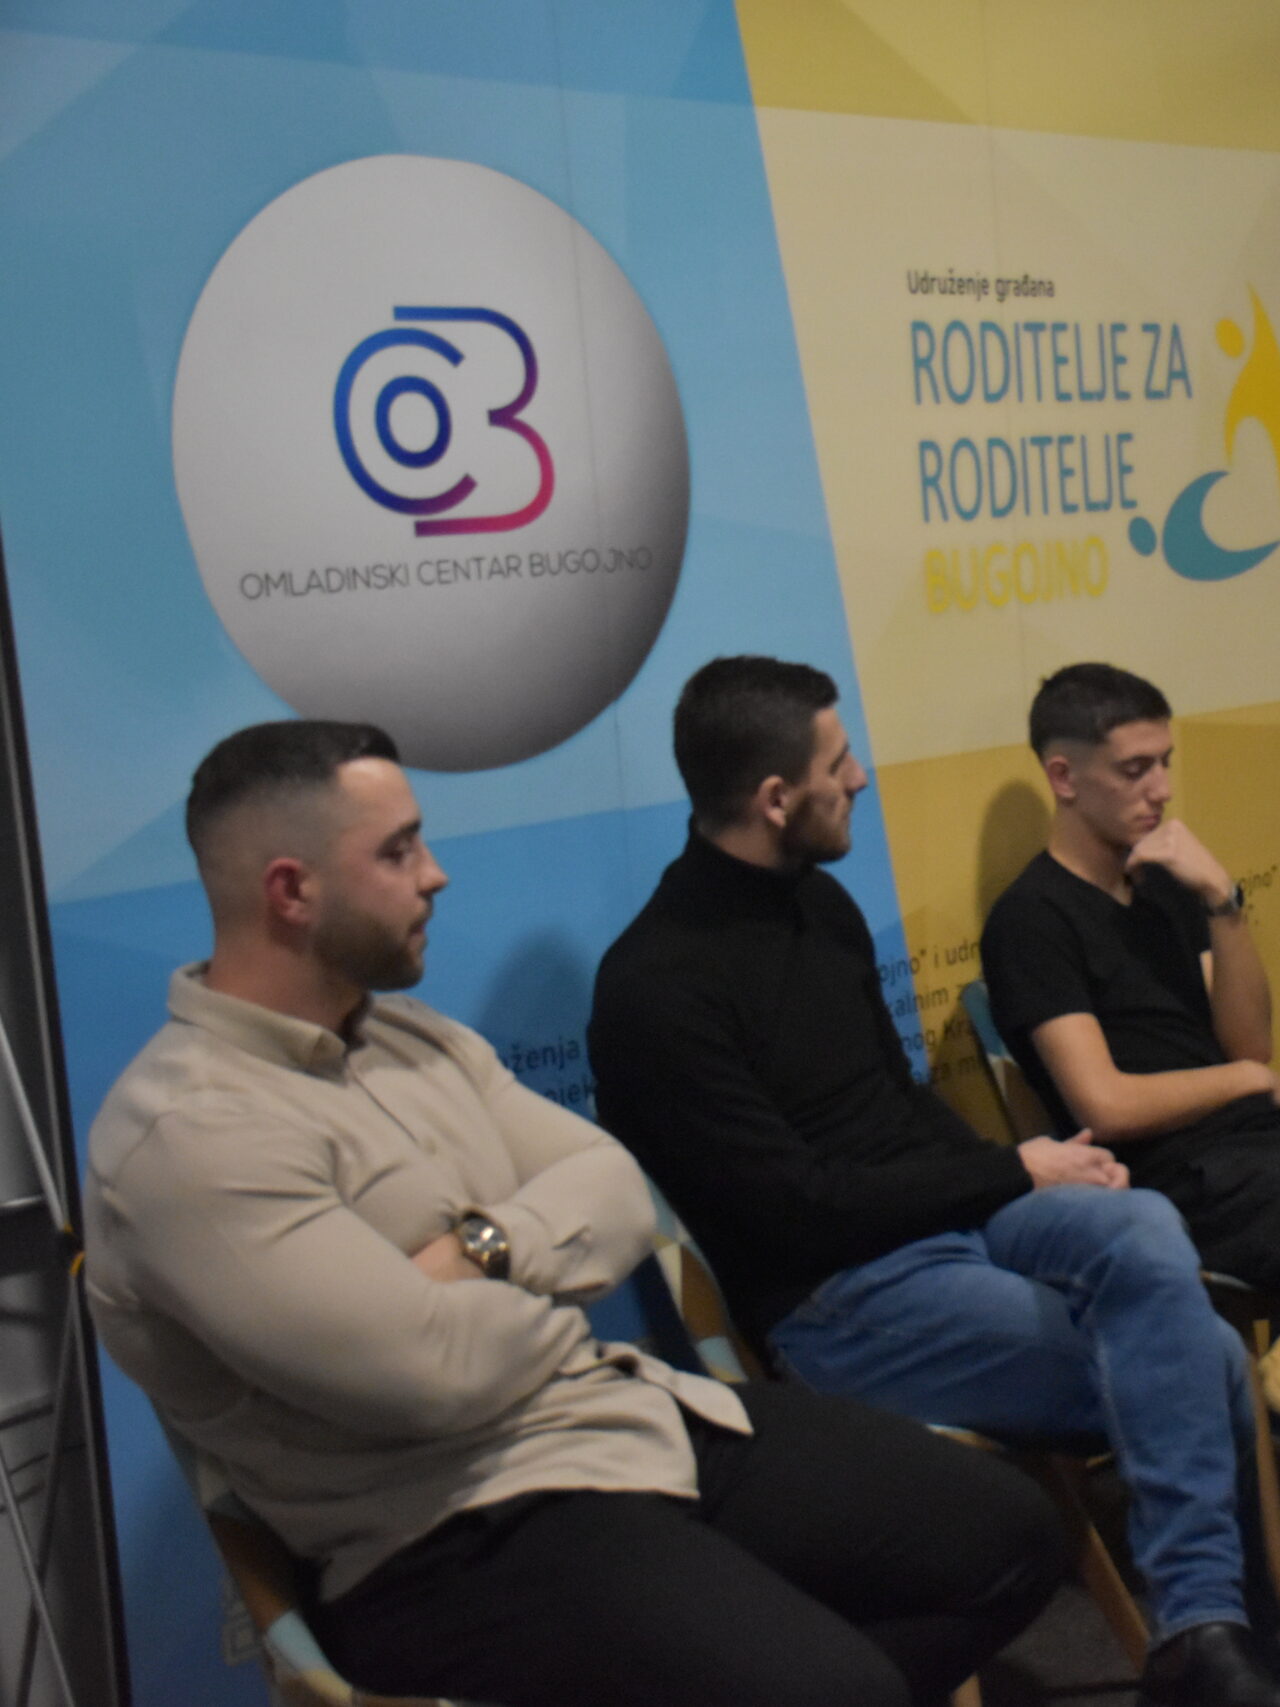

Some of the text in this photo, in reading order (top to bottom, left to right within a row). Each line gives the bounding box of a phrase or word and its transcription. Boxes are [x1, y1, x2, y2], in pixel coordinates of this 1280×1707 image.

[906, 267, 1056, 303] Udruženje građana
[911, 319, 1193, 406] RODITELJE ZA
[918, 431, 1138, 524] RODITELJE
[239, 546, 653, 601] OMLADINSKI CENTAR BUGOJNO
[924, 536, 1109, 614] BUGOJNO
